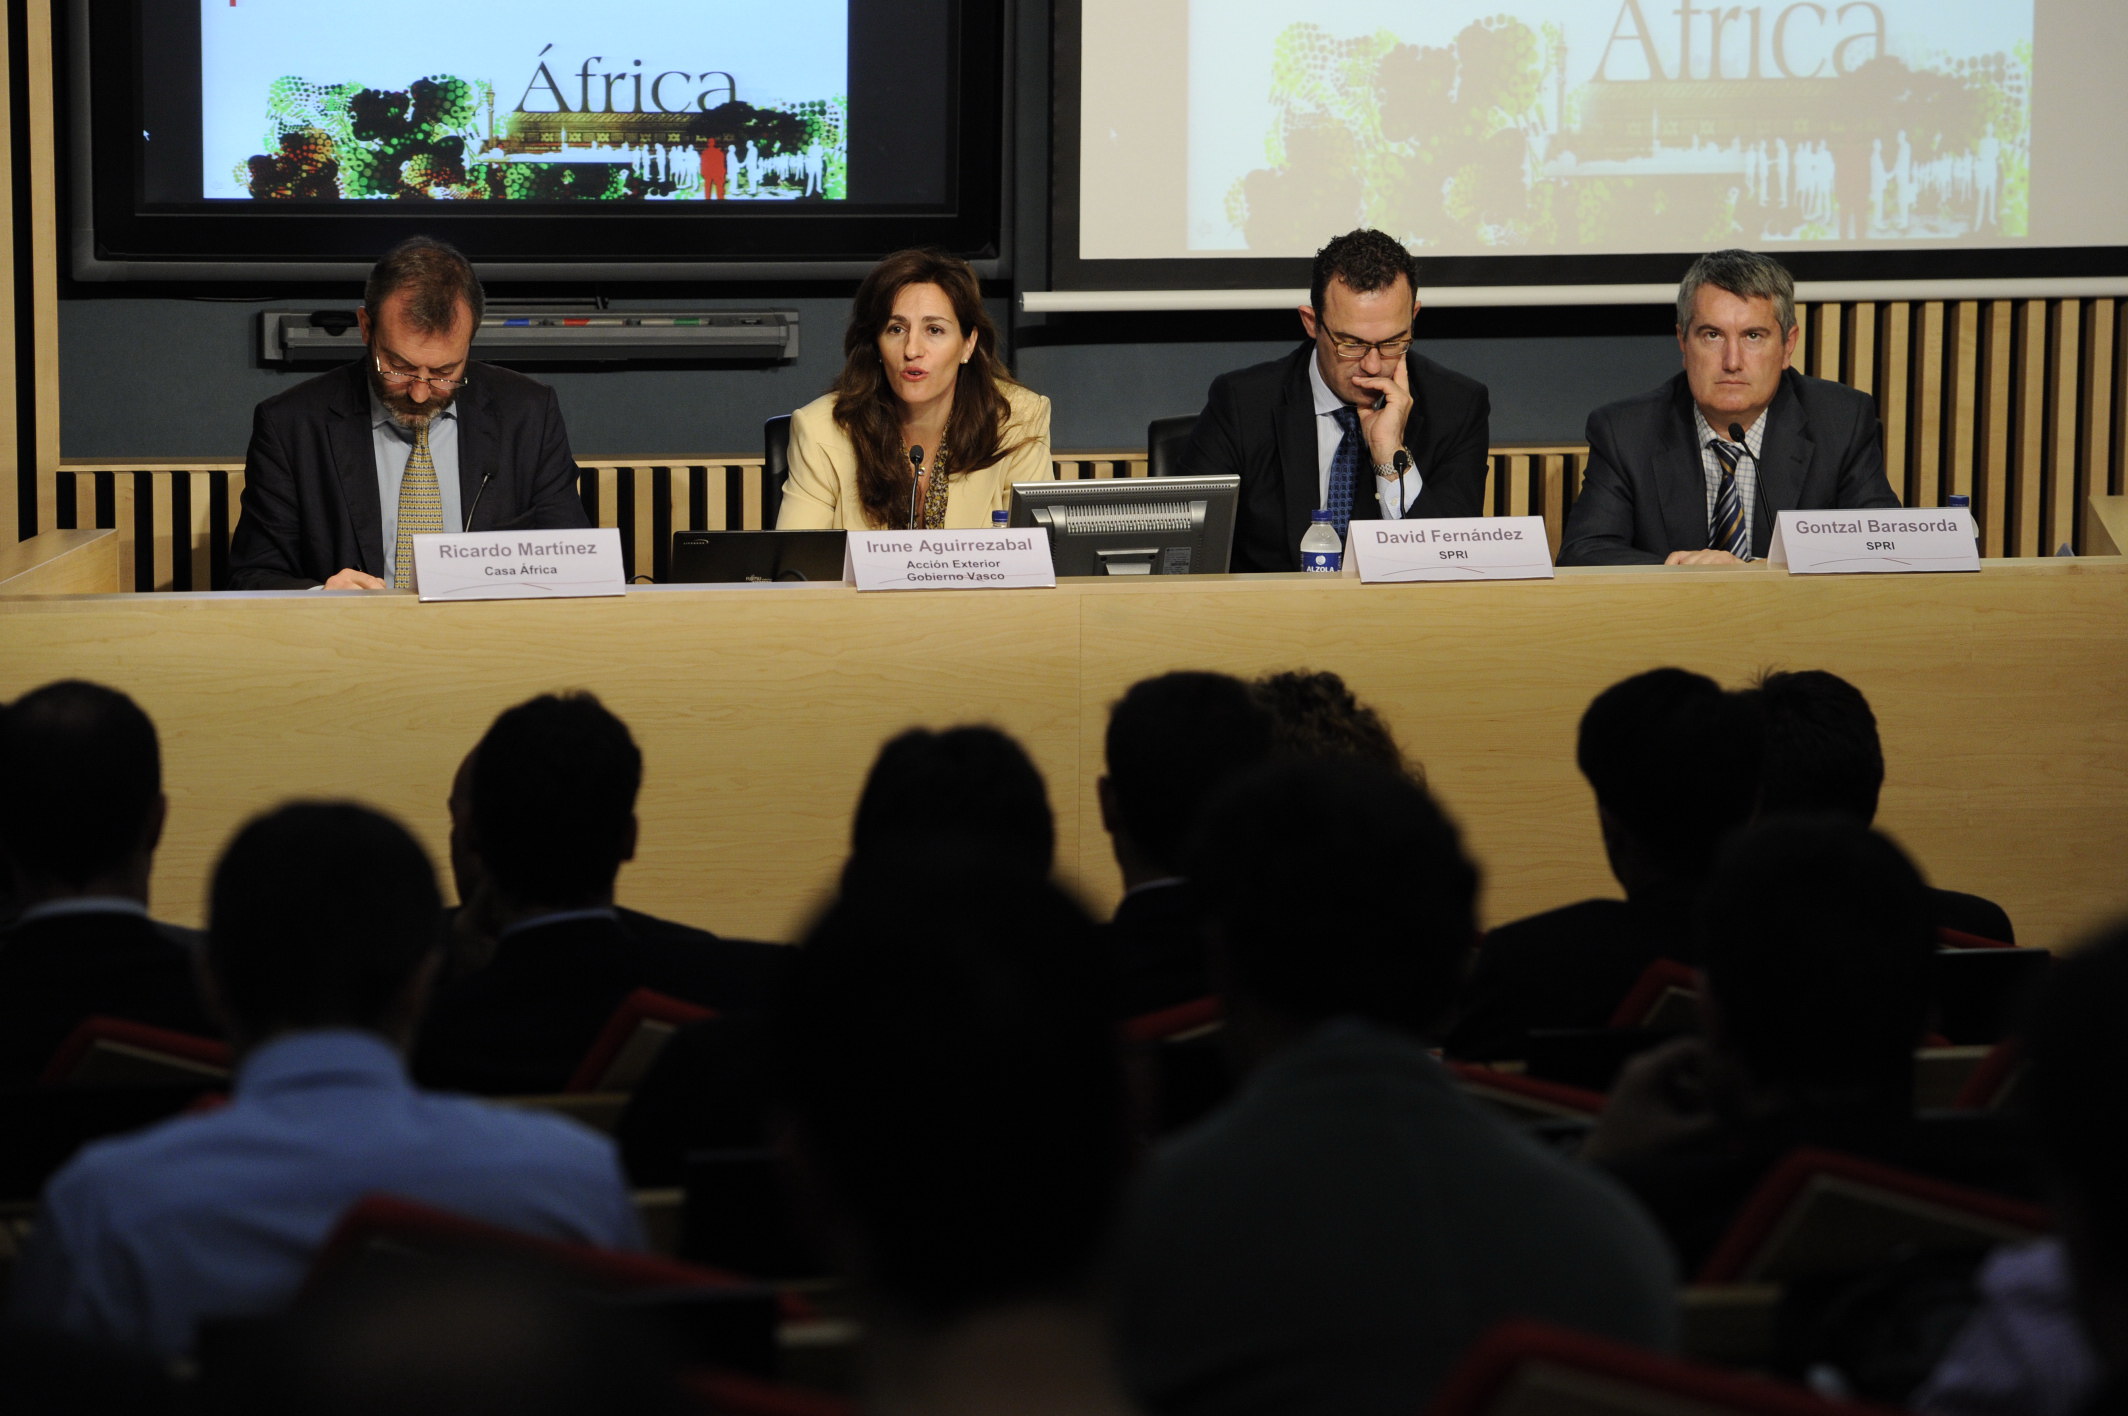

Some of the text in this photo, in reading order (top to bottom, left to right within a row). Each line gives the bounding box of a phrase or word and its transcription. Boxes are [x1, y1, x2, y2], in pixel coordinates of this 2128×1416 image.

[512, 43, 737, 113] África
[1796, 518, 1958, 535] Gontzal Barasorda
[1376, 527, 1524, 544] David Fernández
[439, 540, 598, 559] Ricardo Martínez
[866, 537, 1033, 555] Irune Aguirrezabal
[1866, 541, 1895, 551] SPRI
[1439, 550, 1469, 560] SPRI
[484, 563, 558, 576] Casa África
[906, 559, 1001, 569] Acción Exterior
[907, 571, 1005, 582] Gobierno Vasco
